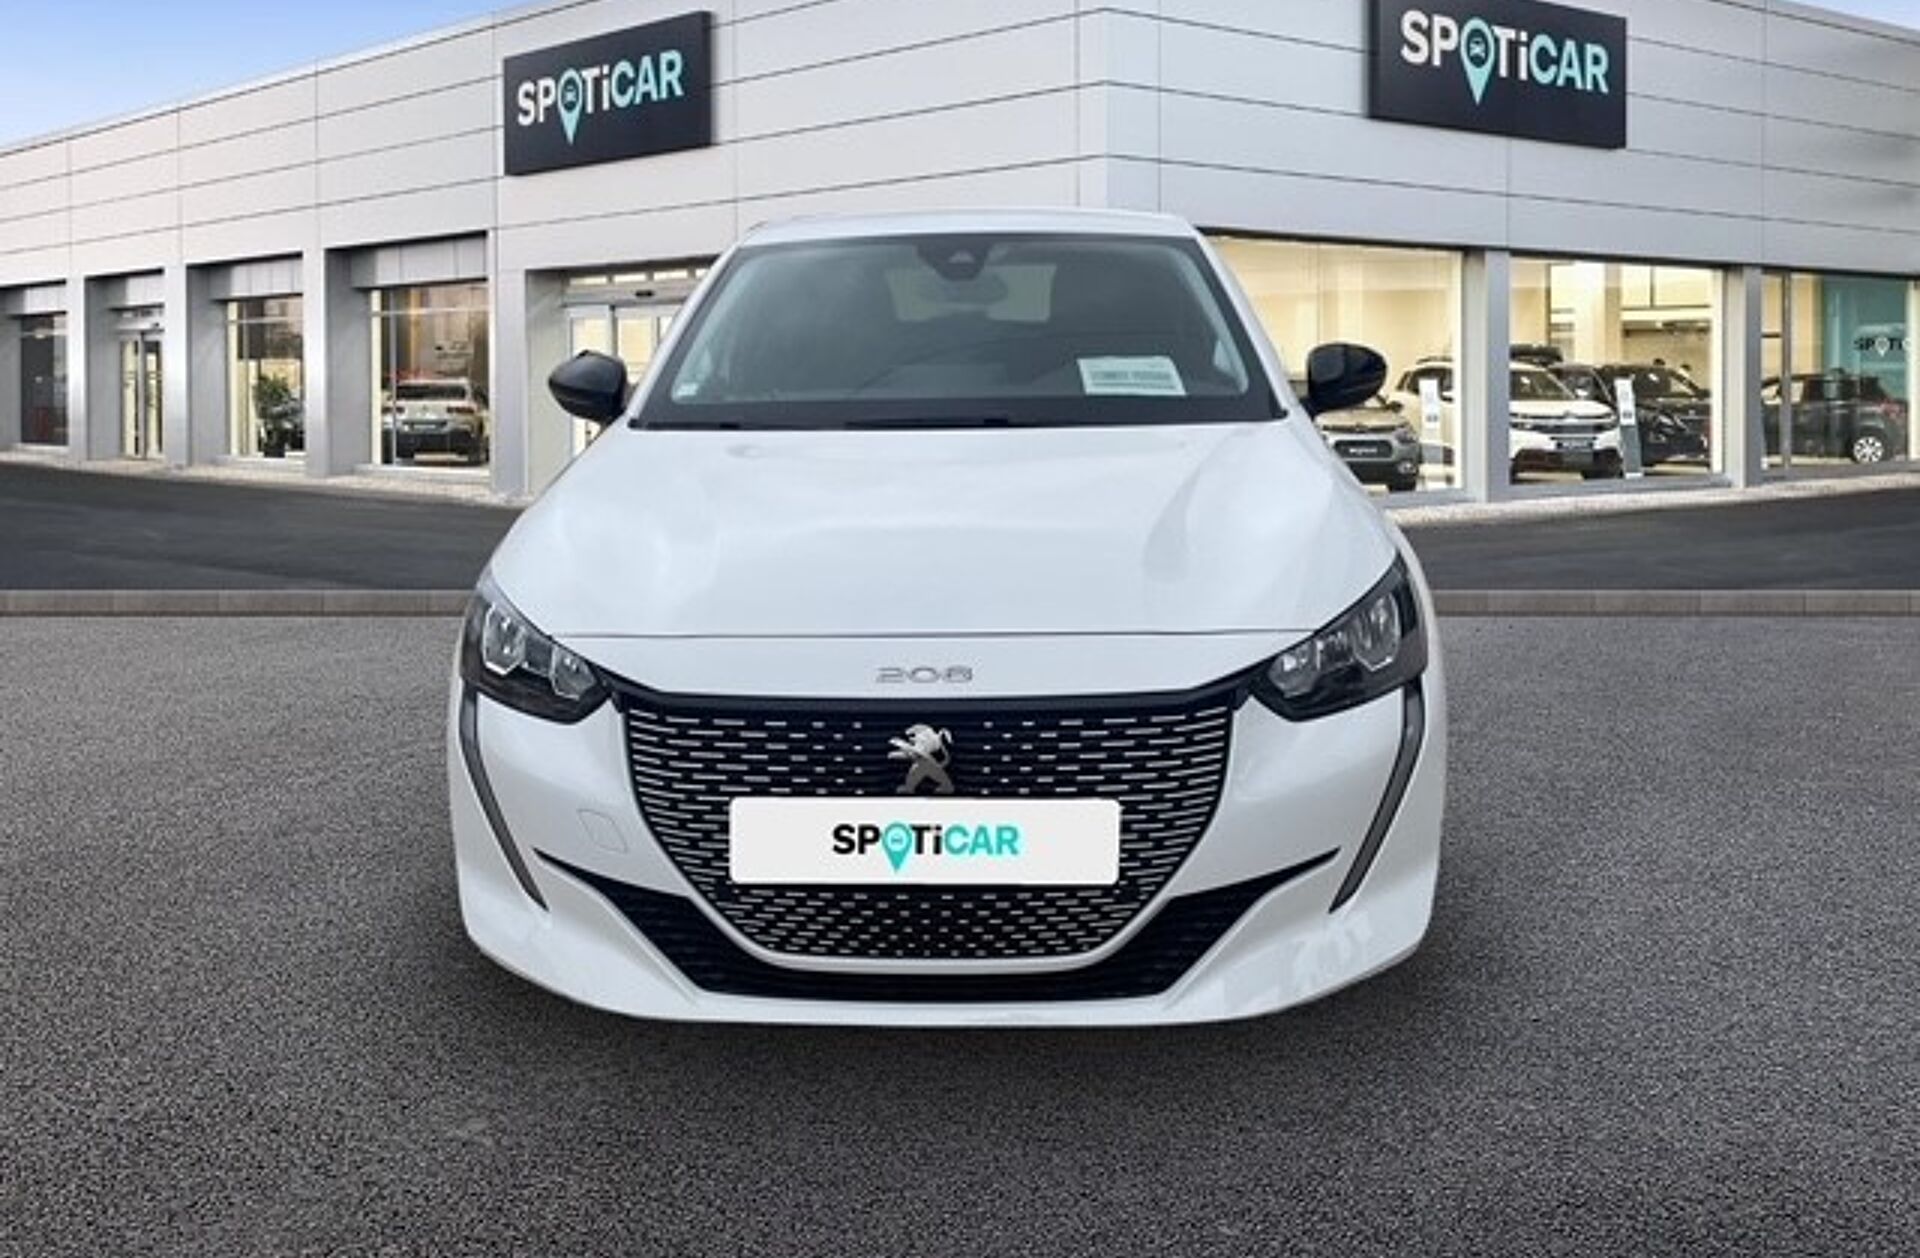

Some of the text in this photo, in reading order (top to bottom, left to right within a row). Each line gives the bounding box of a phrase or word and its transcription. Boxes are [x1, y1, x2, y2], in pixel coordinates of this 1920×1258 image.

[1401, 10, 1609, 105] SPOTiCAR
[518, 50, 683, 145] SPOTiCAR
[876, 665, 973, 683] 208
[832, 822, 1020, 872] SPOTiCAR
